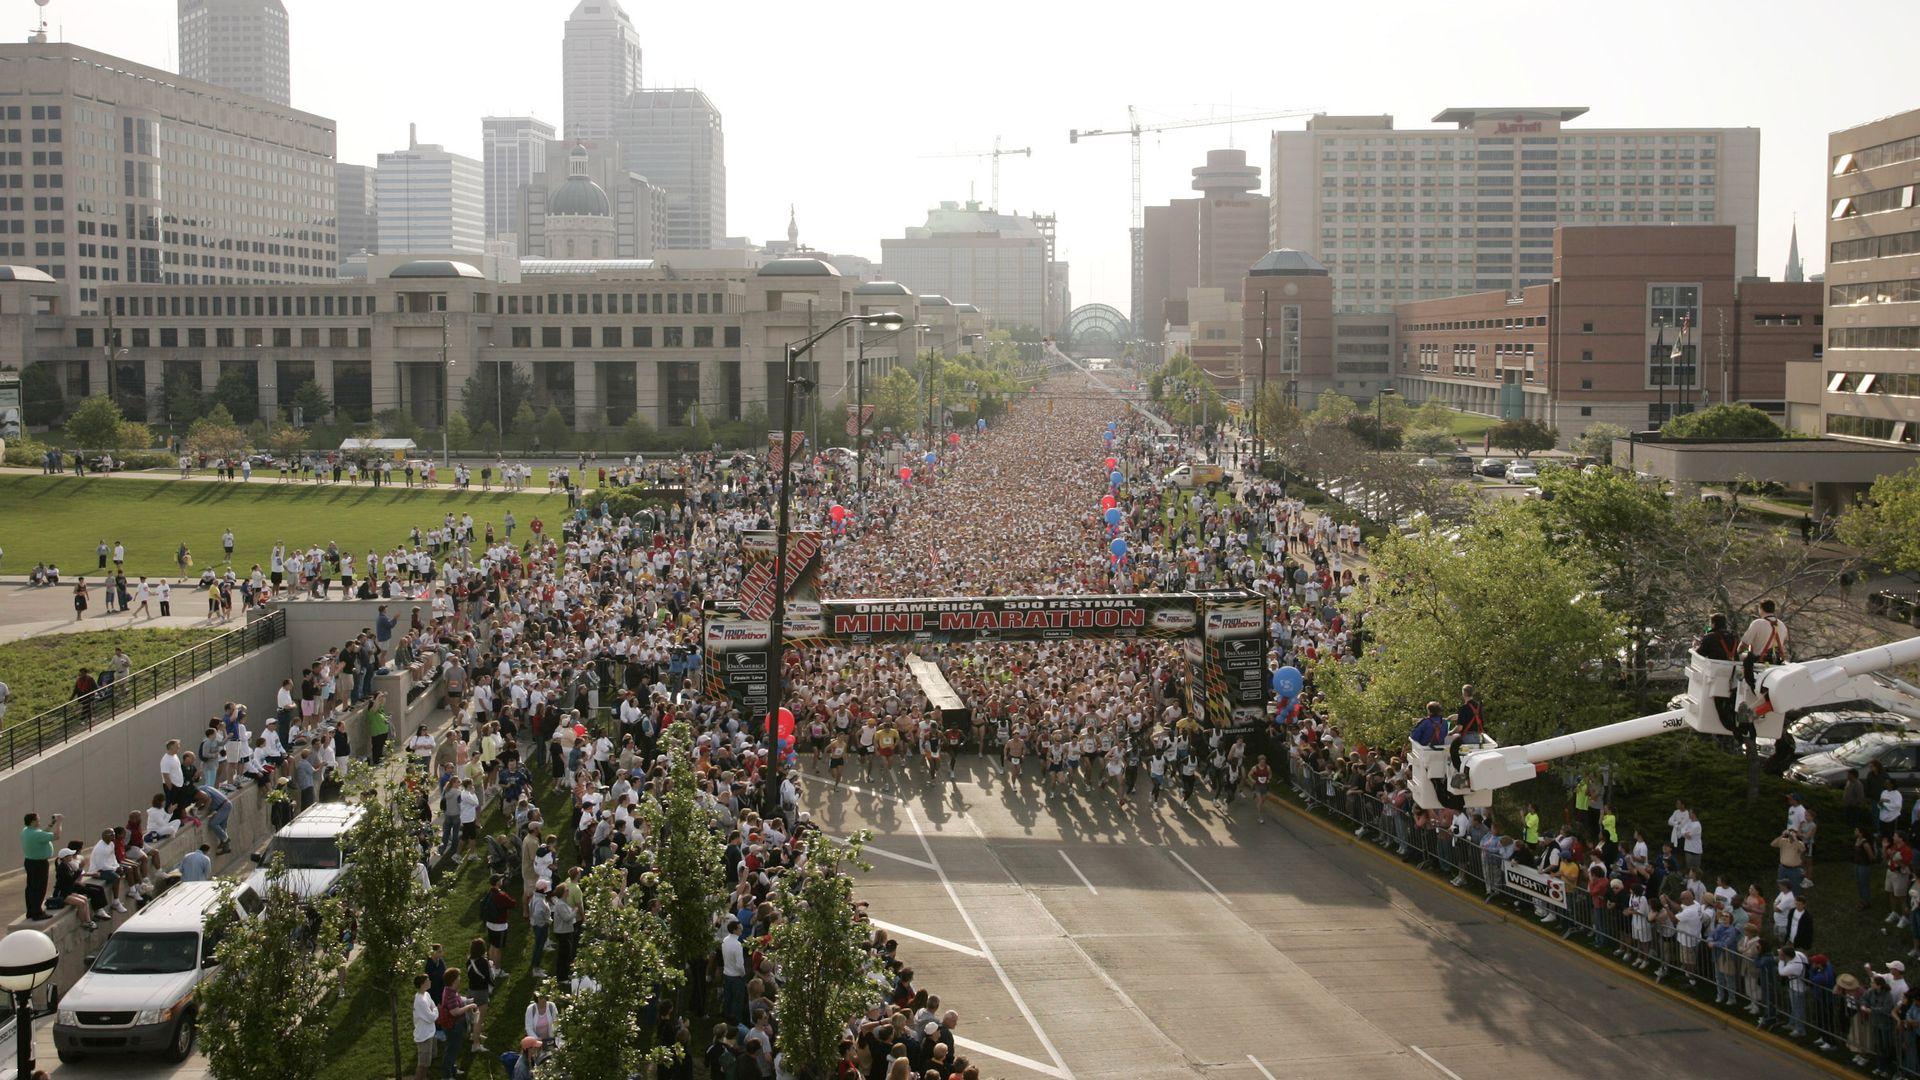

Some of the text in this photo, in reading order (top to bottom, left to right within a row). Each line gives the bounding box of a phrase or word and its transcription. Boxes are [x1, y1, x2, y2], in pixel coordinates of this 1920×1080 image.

[1003, 601, 1044, 609] 500
[1050, 600, 1137, 608] FESTIVAL
[835, 608, 1145, 633] MINI-MARATHON
[1222, 620, 1260, 629] marathon
[724, 632, 767, 640] marathon
